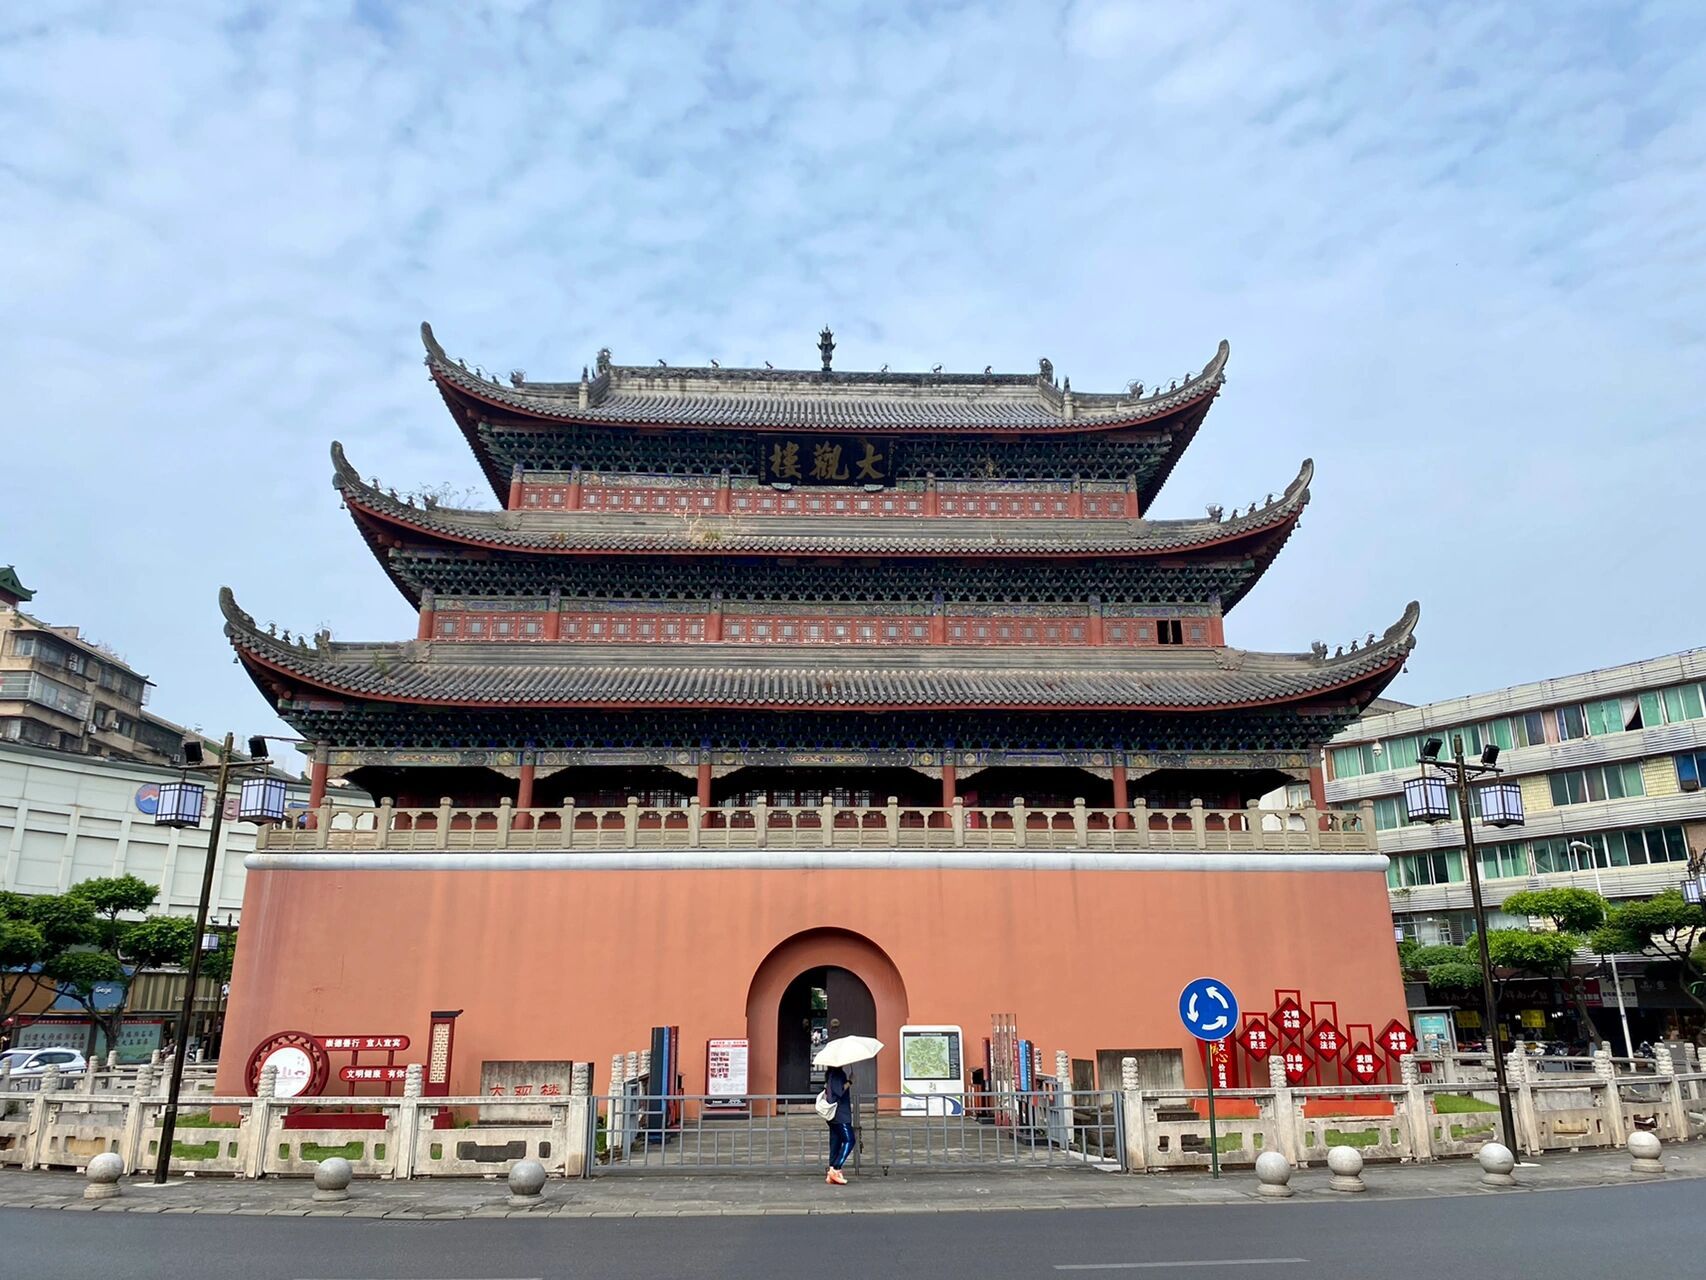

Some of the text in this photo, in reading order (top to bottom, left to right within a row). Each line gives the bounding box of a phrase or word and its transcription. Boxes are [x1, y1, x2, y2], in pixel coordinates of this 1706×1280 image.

[1283, 1010, 1300, 1019] 文明
[1284, 1019, 1301, 1029] 和谐
[1249, 1031, 1266, 1040] 富强
[1319, 1031, 1336, 1040] 公正
[1389, 1031, 1406, 1041] 诚信
[325, 1039, 401, 1048] 崇德善行 宜人宜宾
[1250, 1041, 1267, 1050] 民主
[1320, 1040, 1337, 1050] 法治
[1390, 1041, 1407, 1050] 友善
[1286, 1053, 1303, 1063] 自由
[1356, 1054, 1373, 1064] 爱国
[1287, 1063, 1304, 1073] 平等
[1357, 1064, 1374, 1073] 敬业
[346, 1069, 382, 1079] 文明健康
